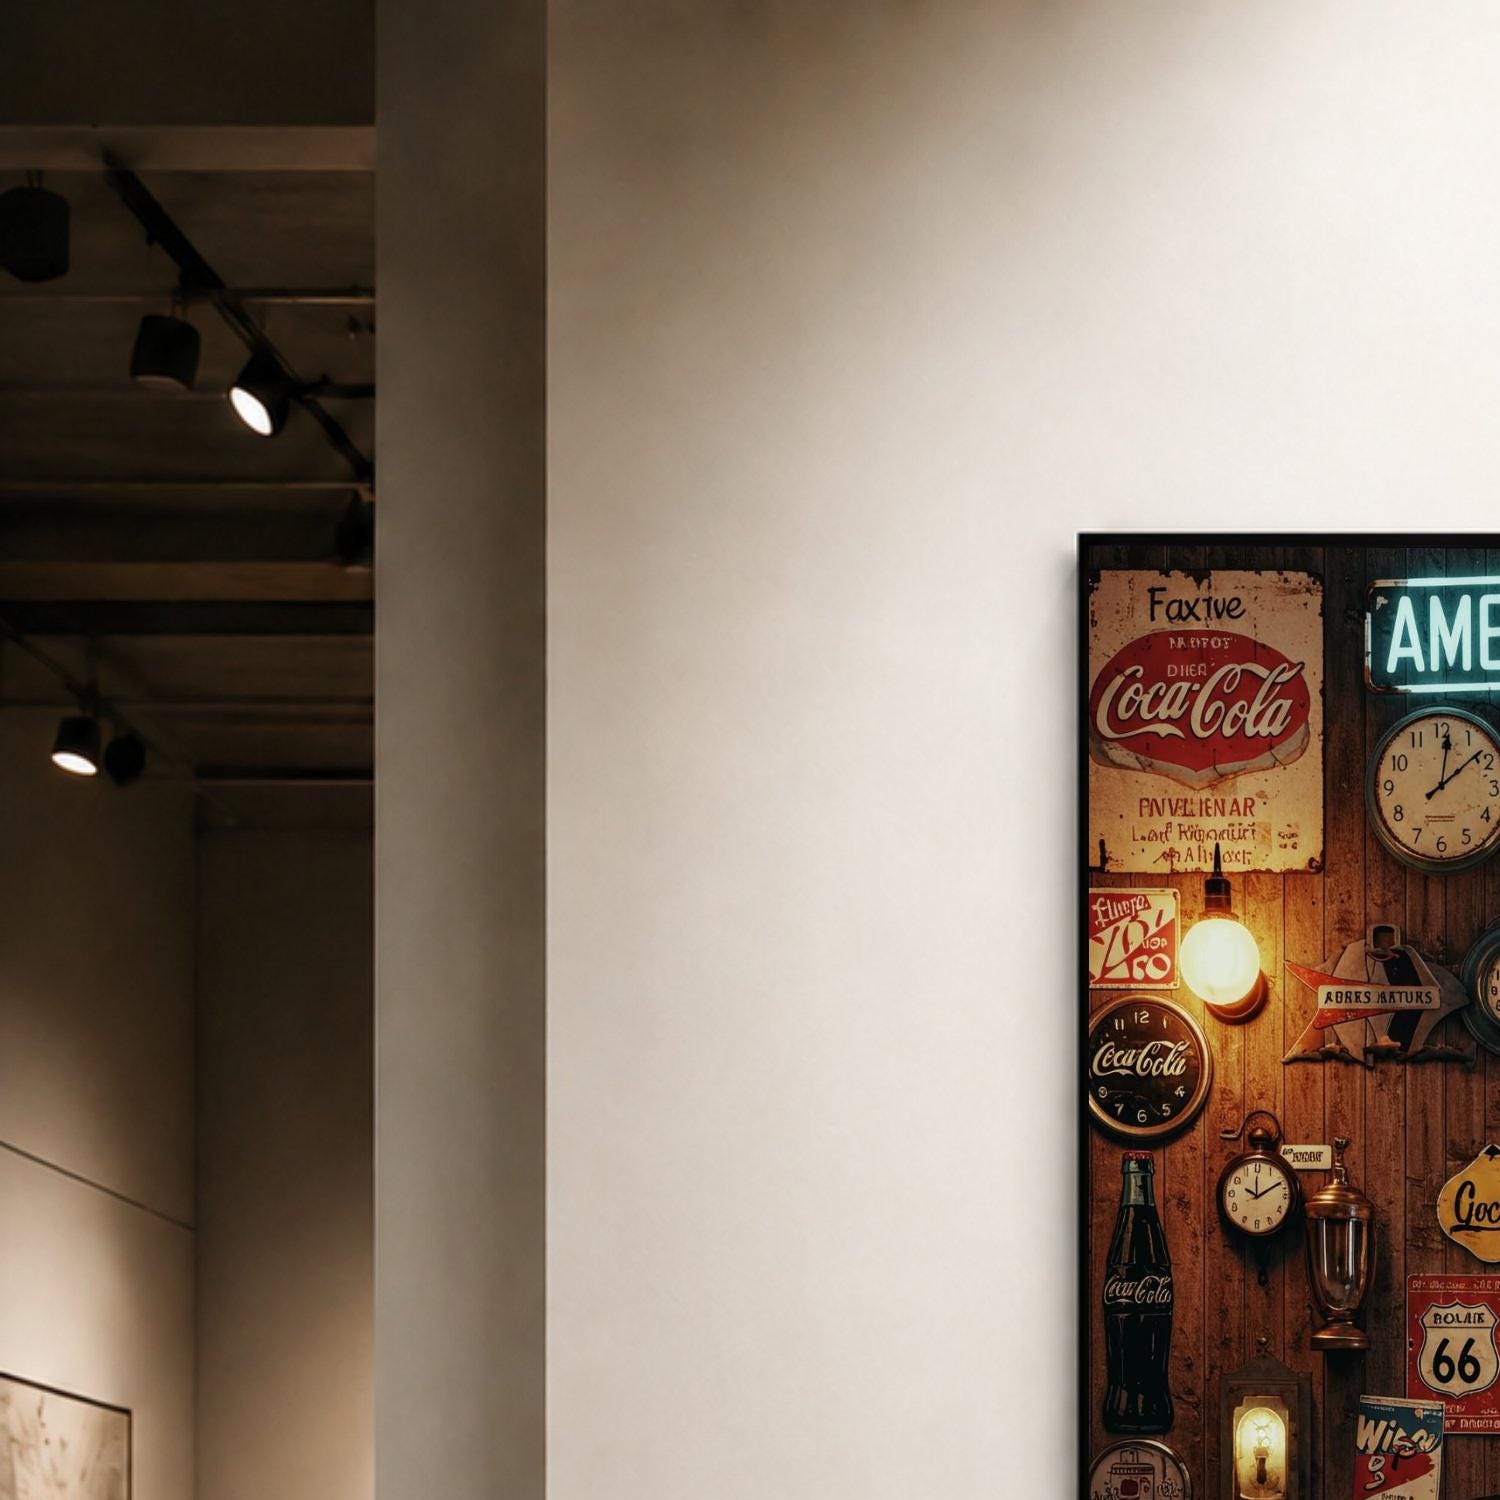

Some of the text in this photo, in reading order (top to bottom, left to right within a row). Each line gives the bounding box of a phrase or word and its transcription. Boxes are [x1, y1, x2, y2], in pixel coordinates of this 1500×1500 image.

[1435, 722, 1450, 739] 12
[1466, 730, 1471, 747] 1
[1410, 732, 1423, 748] 11
[1391, 754, 1408, 772] 10
[1483, 753, 1495, 770] 2
[1383, 780, 1395, 796] 9
[1489, 779, 1500, 797] 3
[1393, 804, 1404, 822] 8
[1480, 806, 1491, 823] 4
[1411, 828, 1422, 844] 7
[1436, 835, 1447, 853] 6
[1461, 828, 1472, 845] 5
[1134, 1010, 1150, 1024] 12
[1114, 1103, 1124, 1117] 7
[1137, 1109, 1148, 1123] 6
[1161, 1103, 1172, 1117] 5
[1433, 1338, 1481, 1384] 66
